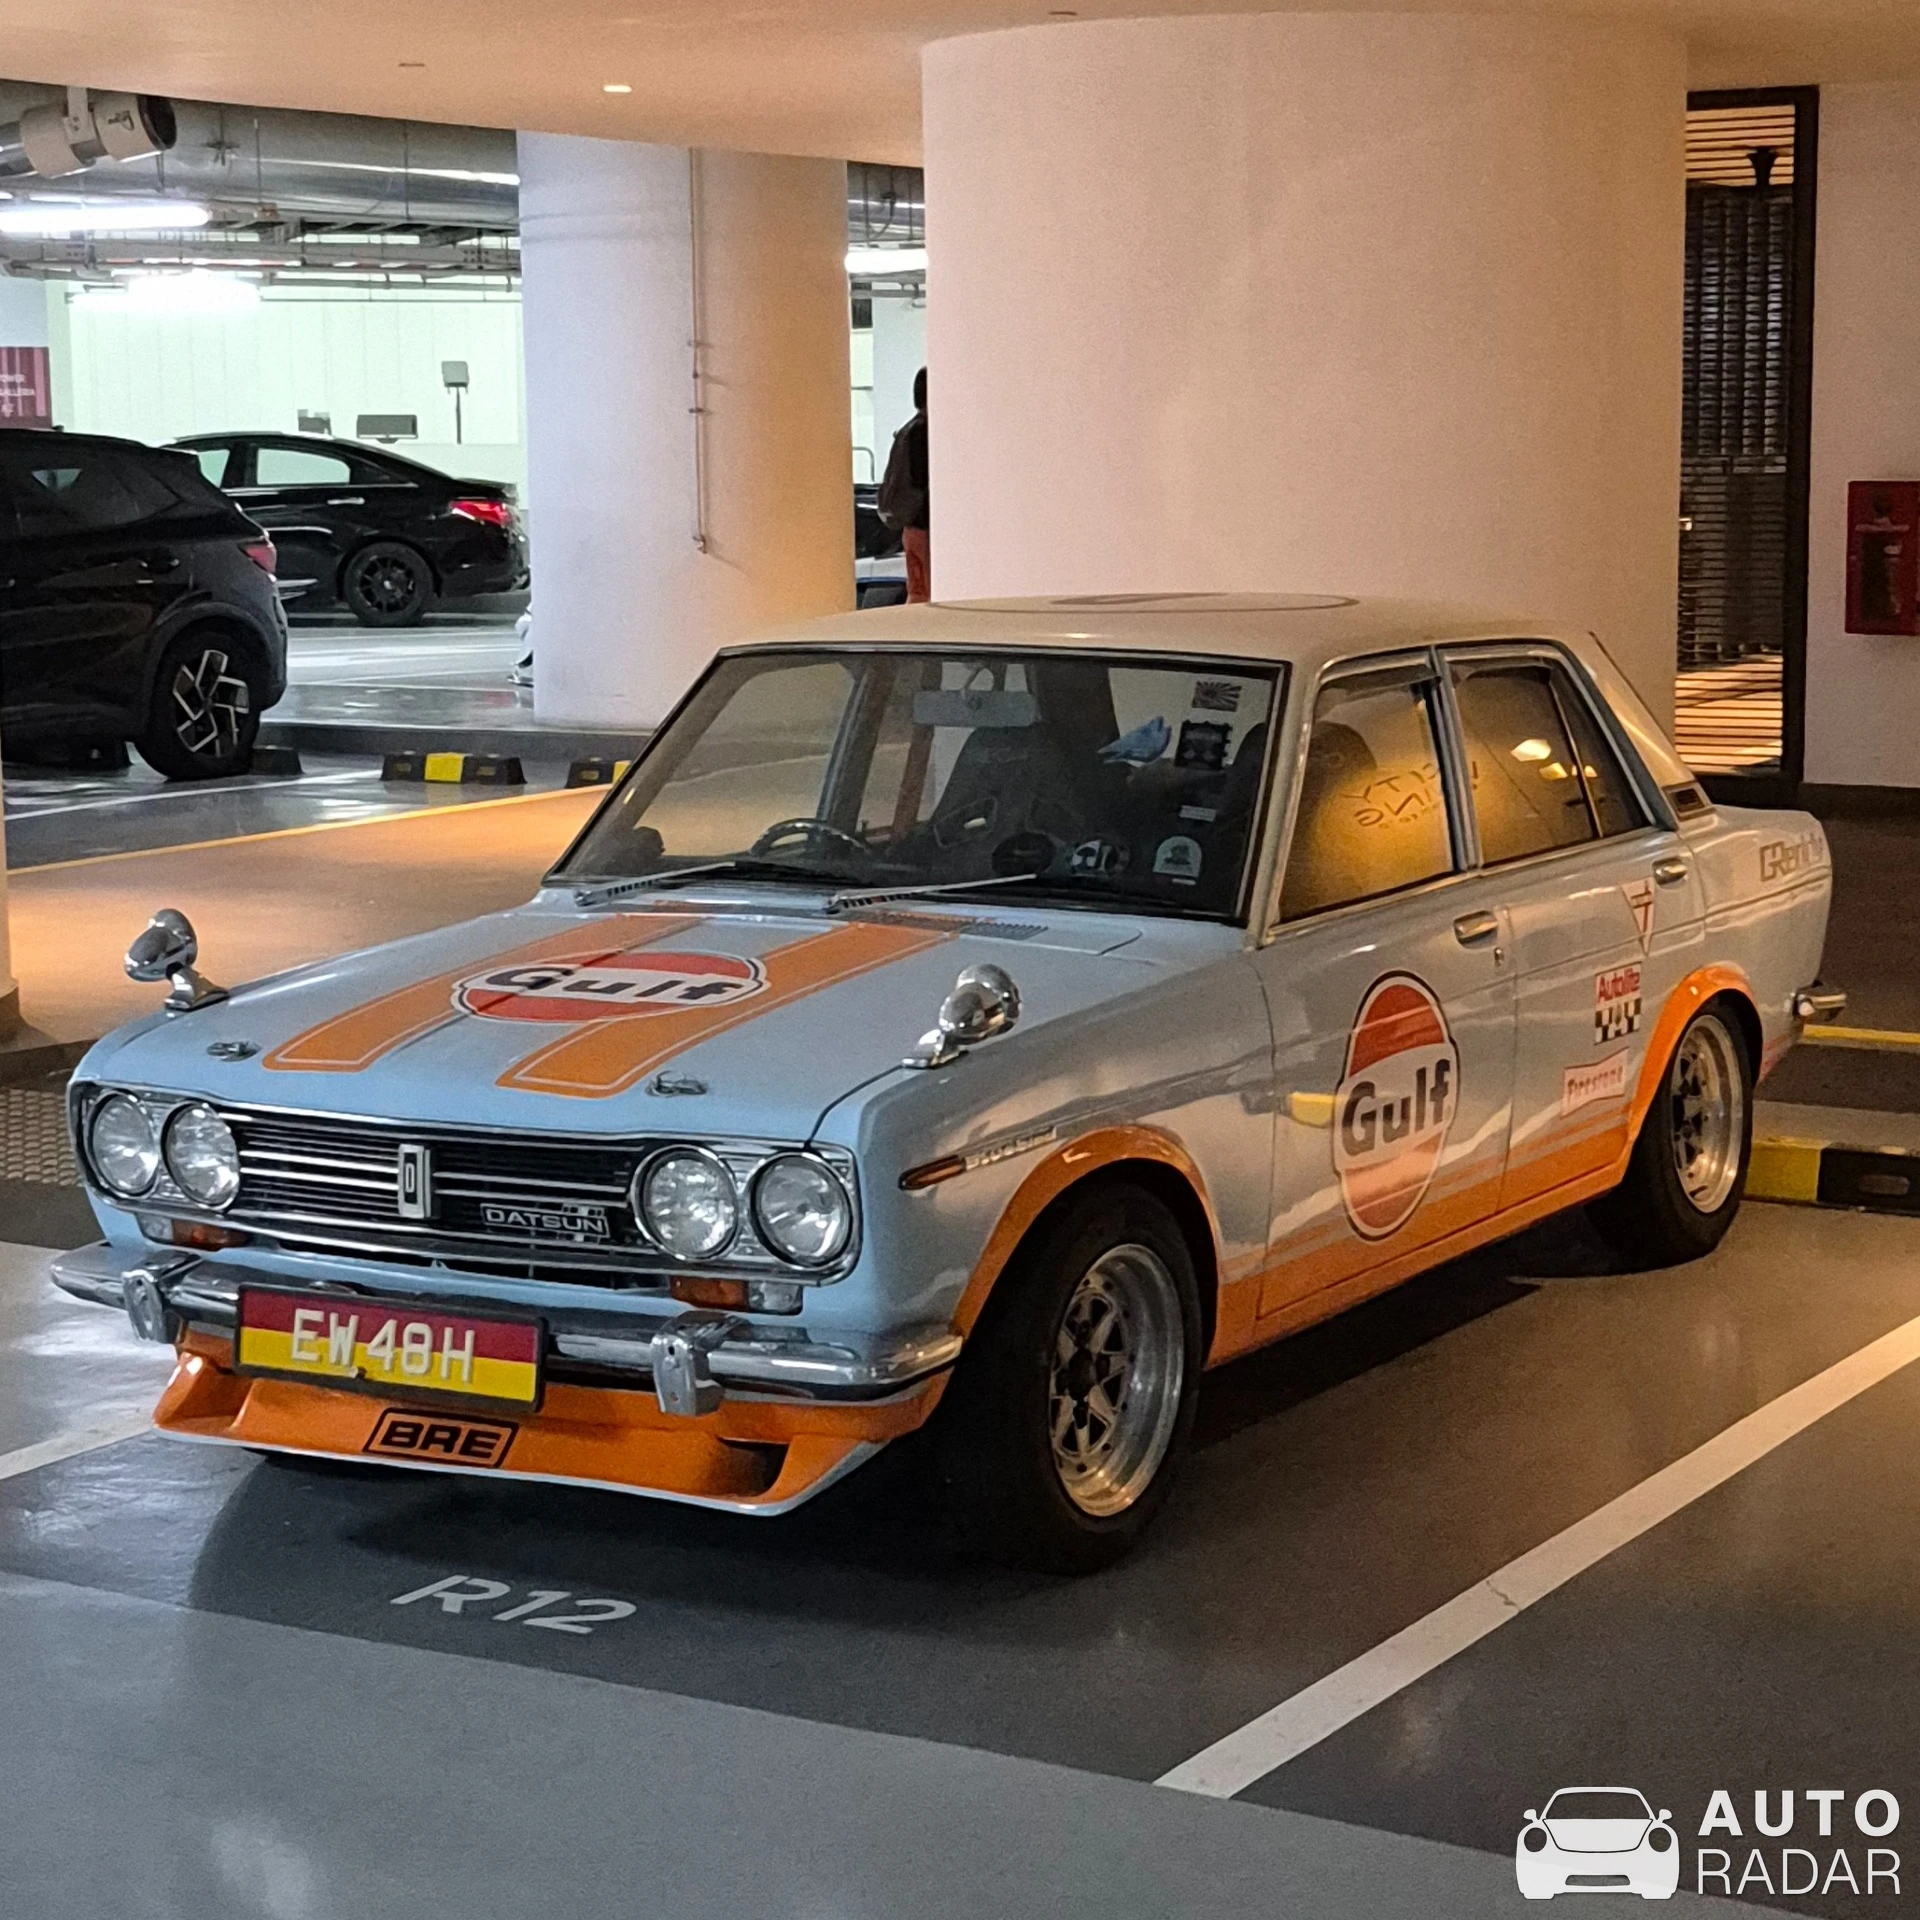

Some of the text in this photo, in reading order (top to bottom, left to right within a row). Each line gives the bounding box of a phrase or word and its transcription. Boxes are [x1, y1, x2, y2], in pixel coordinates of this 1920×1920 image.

[485, 966, 744, 1001] Gulf
[1597, 967, 1640, 1004] Autolite
[1341, 1058, 1451, 1157] Gulf
[485, 1208, 603, 1234] DATSUN
[379, 1420, 503, 1460] BRE
[389, 1574, 638, 1635] R12
